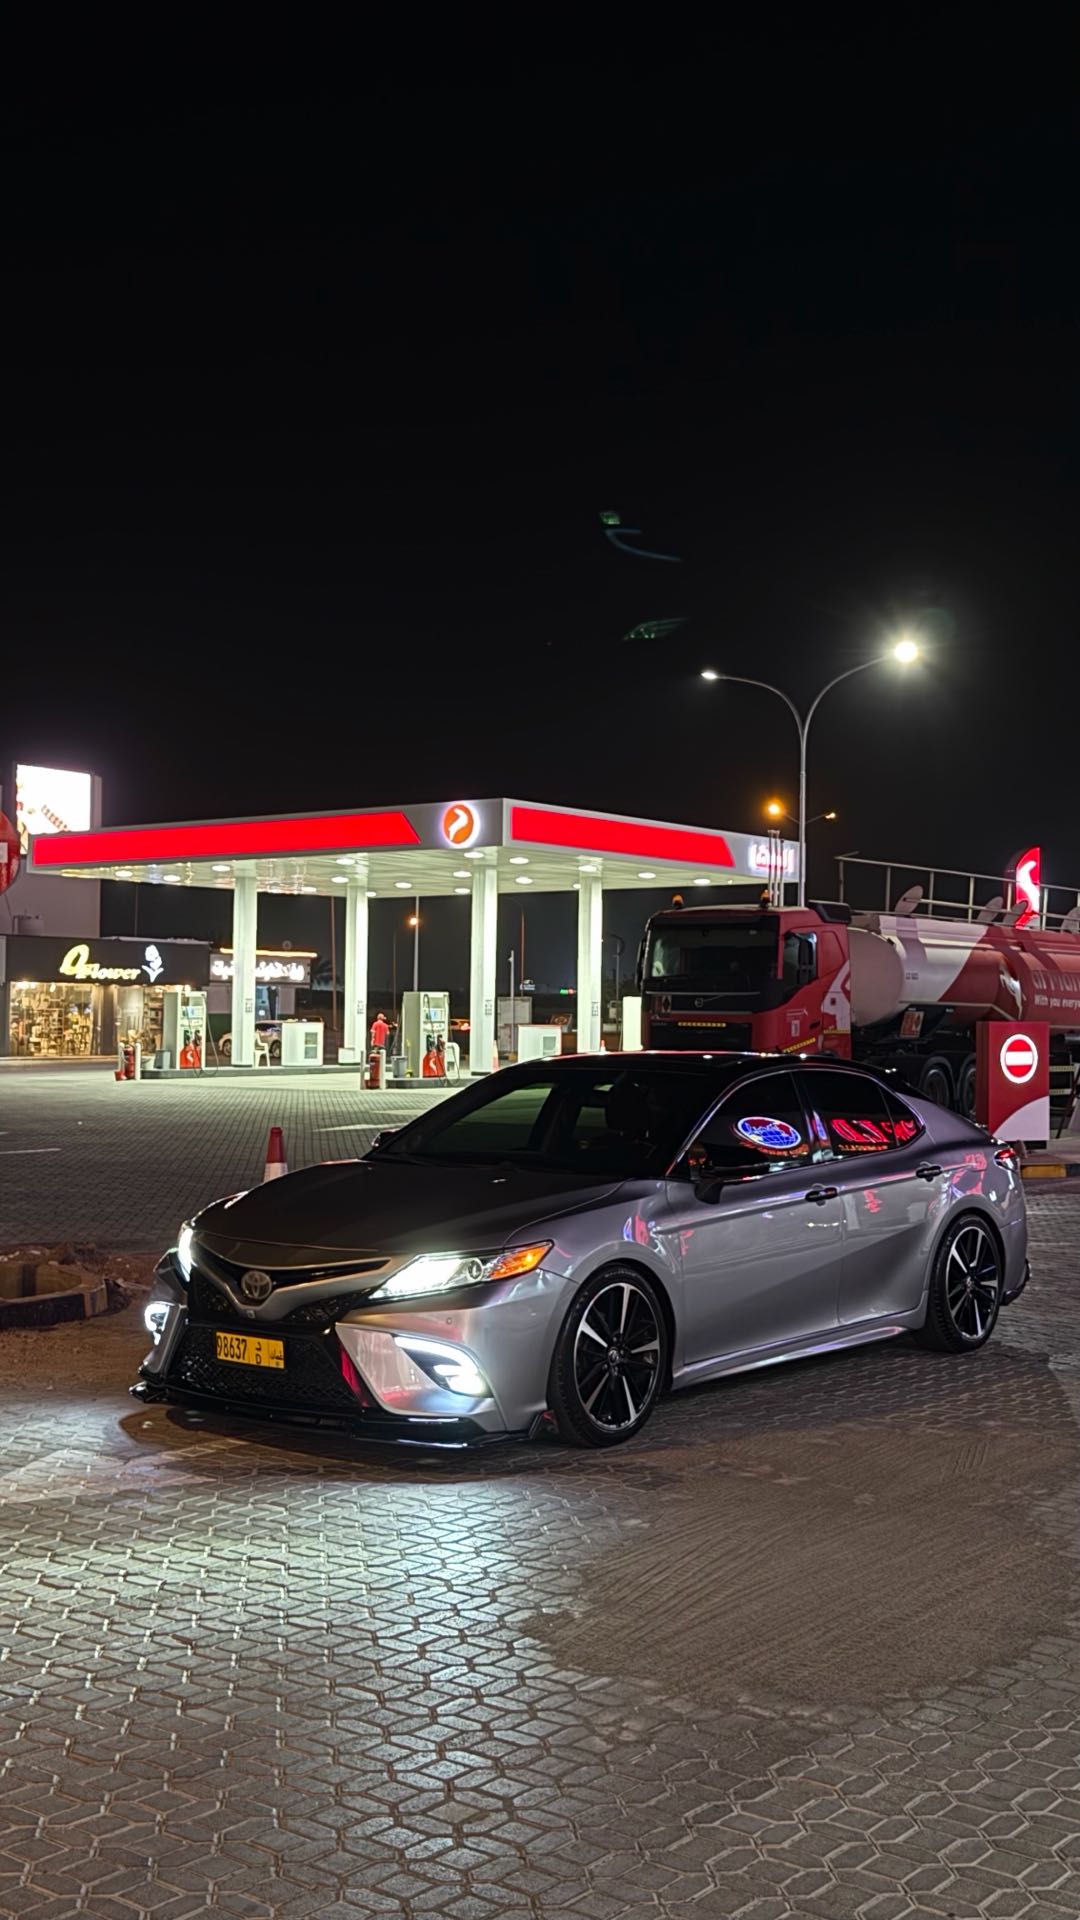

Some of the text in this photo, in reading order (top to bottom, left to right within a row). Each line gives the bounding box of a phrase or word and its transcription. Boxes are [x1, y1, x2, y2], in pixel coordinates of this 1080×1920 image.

[1034, 994, 1048, 1006] With
[1050, 997, 1060, 1009] you
[216, 1335, 248, 1361] 98637
